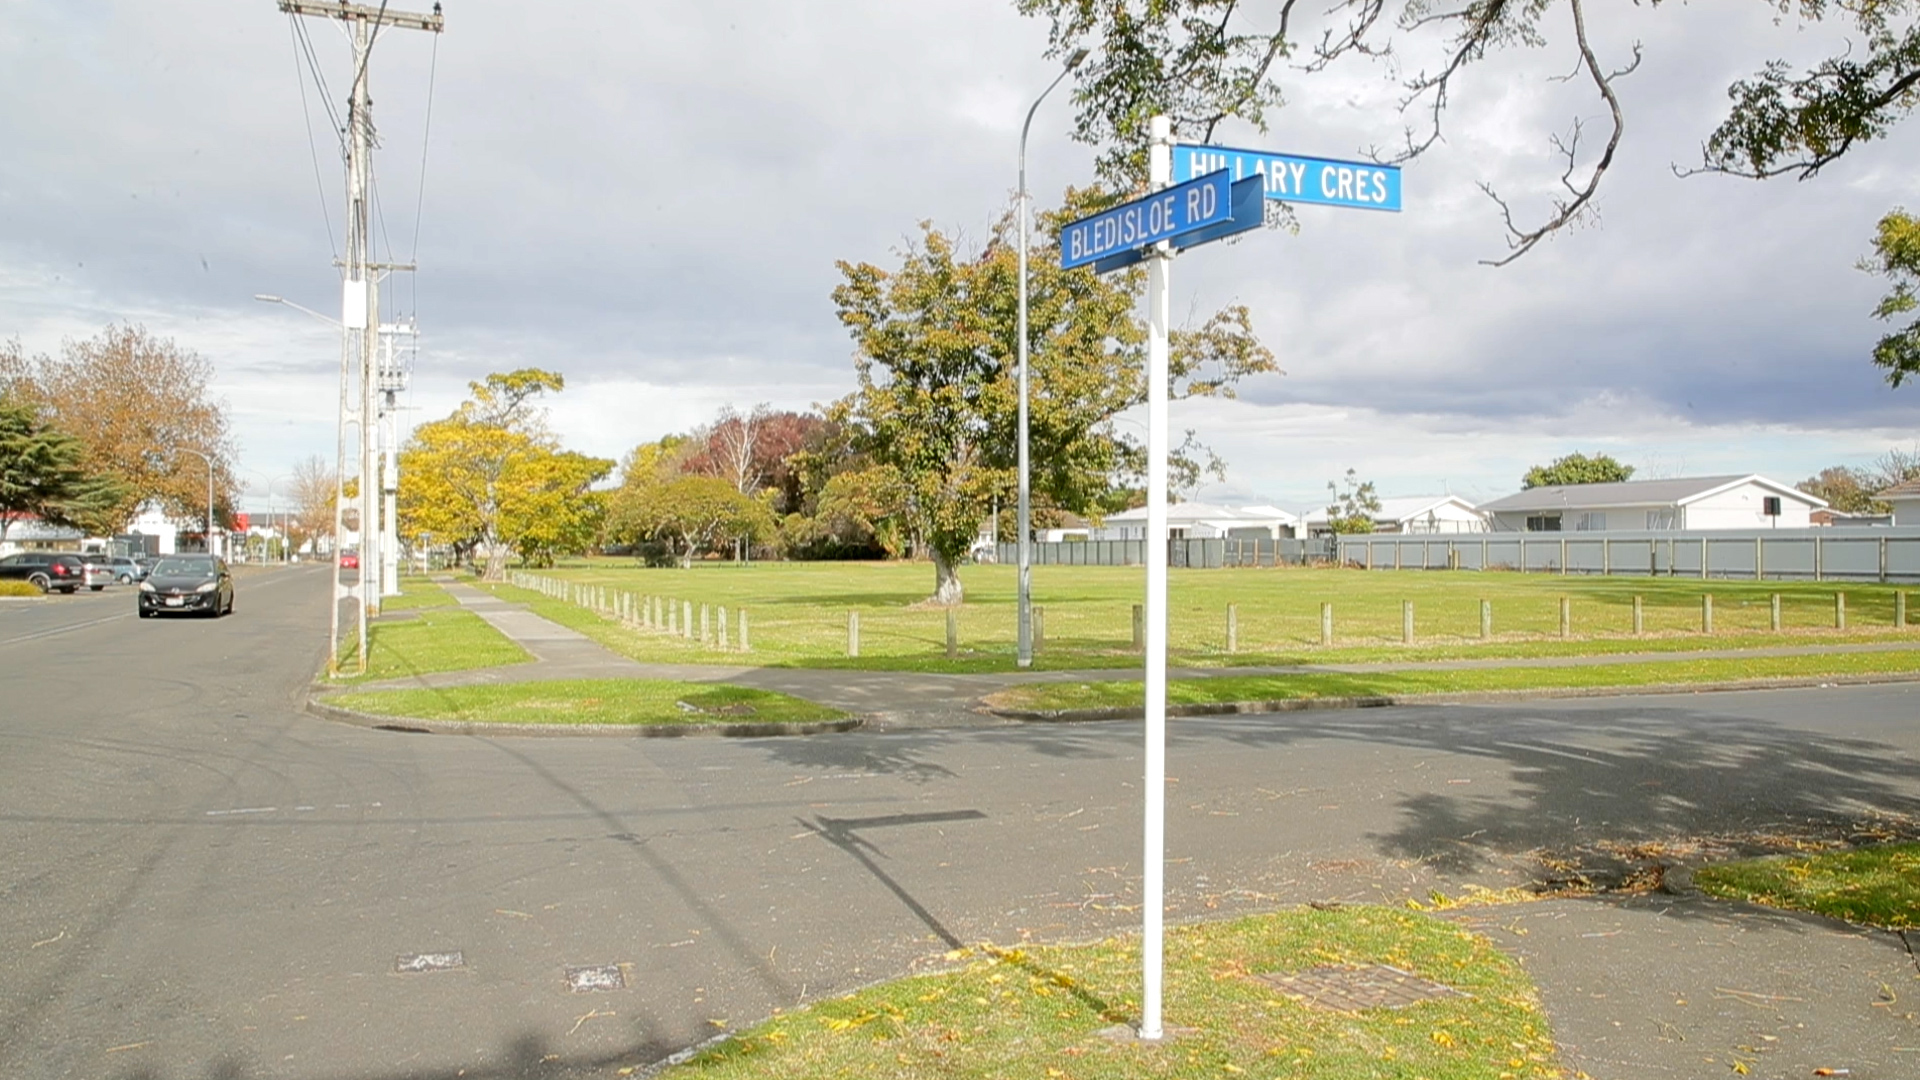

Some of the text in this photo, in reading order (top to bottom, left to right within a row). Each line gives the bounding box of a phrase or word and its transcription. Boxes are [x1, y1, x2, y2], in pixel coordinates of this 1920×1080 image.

[1321, 166, 1387, 204] CRES
[1071, 183, 1216, 261] BLEDISLOE RD
